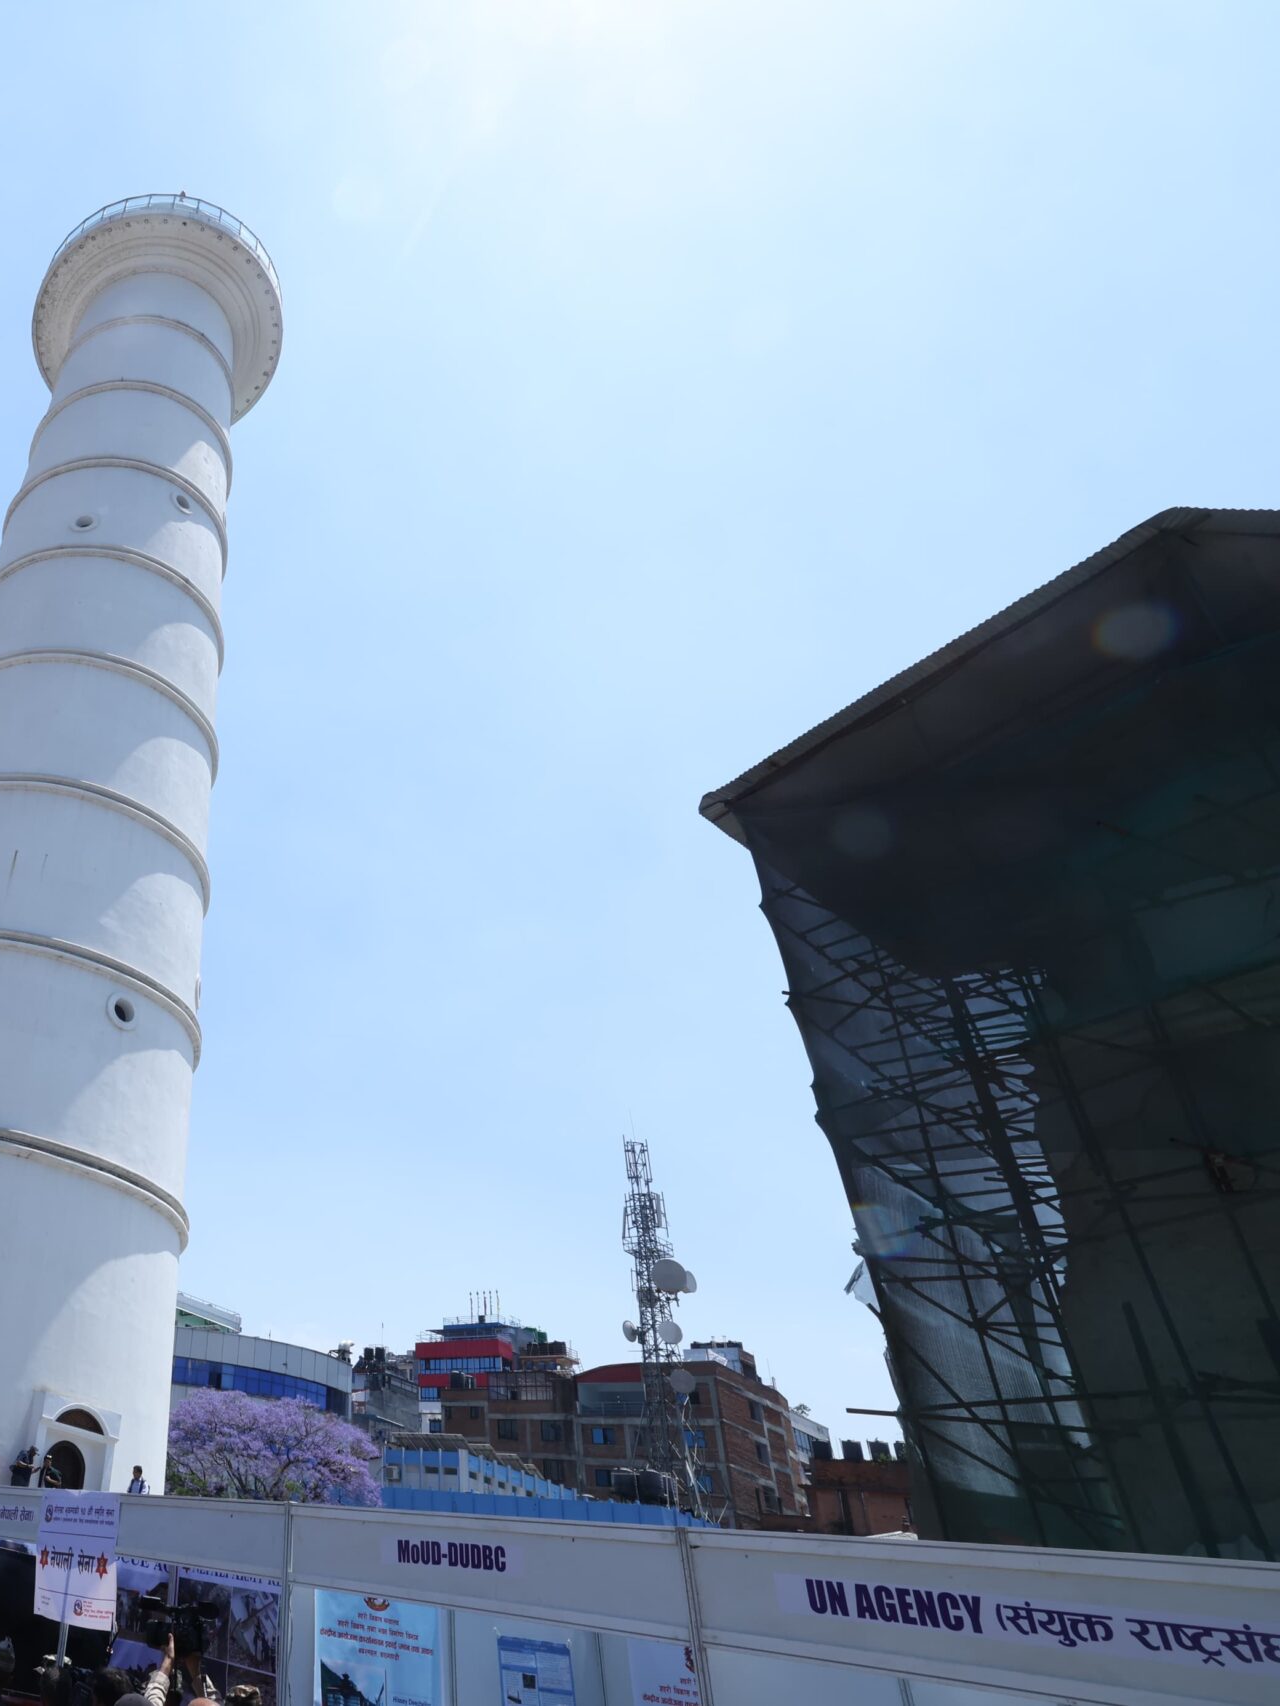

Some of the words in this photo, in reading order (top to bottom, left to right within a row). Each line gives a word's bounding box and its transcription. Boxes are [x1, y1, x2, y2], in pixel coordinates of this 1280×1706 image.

[51, 1547, 74, 1572] नेपाली
[78, 1551, 96, 1574] सेना
[397, 1539, 506, 1572] MoUD-DUDBC
[805, 1578, 850, 1617] UN
[854, 1583, 983, 1634] AGENCY
[995, 1601, 1114, 1648] (संयुक्त
